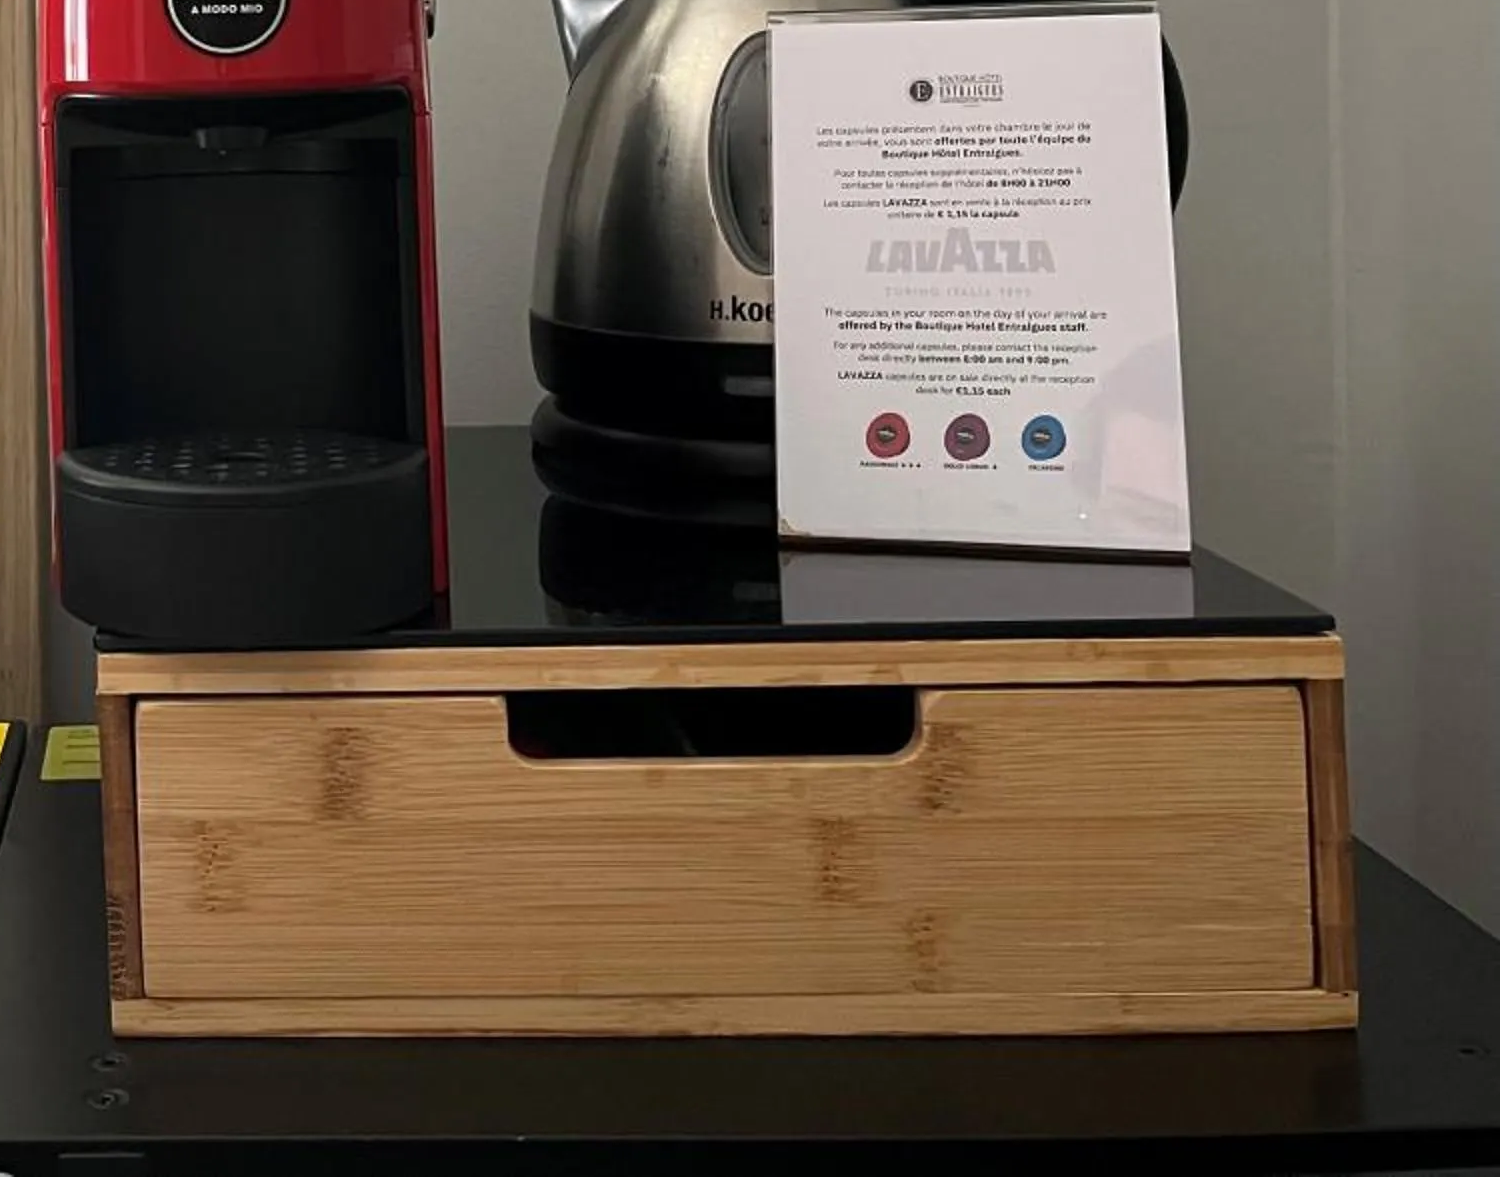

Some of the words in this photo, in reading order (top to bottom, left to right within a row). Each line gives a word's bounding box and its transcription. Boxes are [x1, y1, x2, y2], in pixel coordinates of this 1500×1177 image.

[191, 6, 199, 14] A
[201, 5, 238, 15] MODO
[240, 4, 264, 14] MIO
[995, 122, 1040, 132] chambre
[1077, 122, 1091, 130] de
[934, 136, 976, 145] offertes
[979, 137, 996, 146] par
[999, 136, 1028, 144] toute
[1077, 134, 1091, 143] du
[881, 149, 929, 160] Boutique
[931, 149, 960, 158] Hôtel
[986, 177, 998, 187] de
[1038, 177, 1071, 187] 21H00
[882, 198, 927, 207] LAVAZZA
[982, 209, 1019, 220] capsule
[866, 227, 1056, 273] LAVAZZA
[825, 307, 842, 317] The
[844, 309, 889, 319] capsules
[903, 310, 926, 319] your
[929, 310, 956, 318] room
[973, 309, 990, 317] the
[993, 309, 1012, 320] day
[1015, 309, 1025, 317] of
[1027, 310, 1051, 320] your
[838, 321, 877, 330] offered
[879, 321, 893, 331] by
[895, 321, 913, 329] the
[915, 321, 963, 332] Boutique
[966, 322, 996, 331] Hotel
[998, 322, 1057, 333] Entraigues
[1060, 322, 1089, 331] staff.
[833, 342, 847, 350] For
[850, 343, 866, 352] any
[868, 341, 914, 350] additional
[961, 343, 993, 353] please
[995, 343, 1031, 352] contact
[1033, 343, 1049, 352] the
[918, 354, 961, 363] between
[988, 356, 1004, 364] am
[1006, 355, 1025, 364] and
[838, 371, 883, 380] LAVAZZA
[928, 374, 944, 382] are
[945, 374, 957, 382] on
[987, 386, 1011, 396] each
